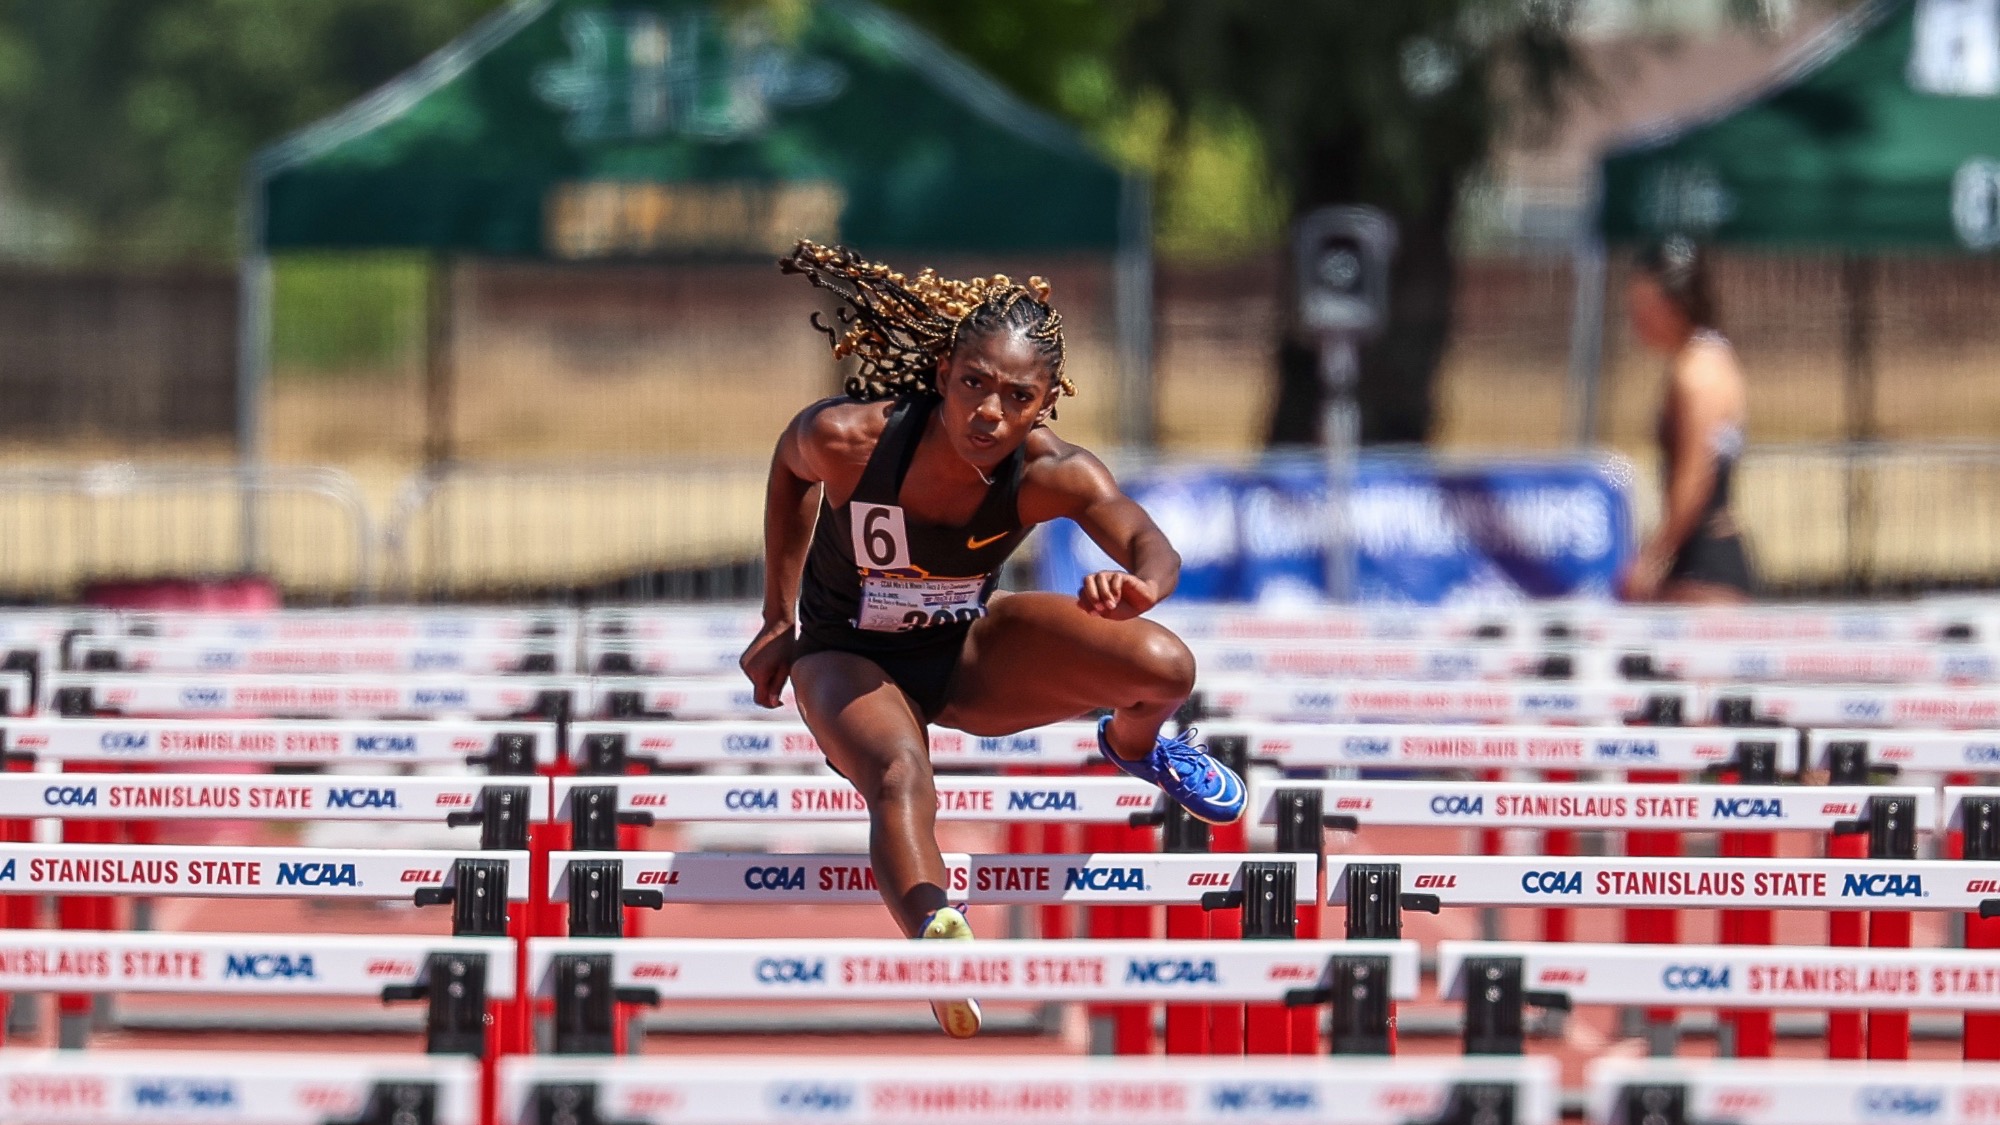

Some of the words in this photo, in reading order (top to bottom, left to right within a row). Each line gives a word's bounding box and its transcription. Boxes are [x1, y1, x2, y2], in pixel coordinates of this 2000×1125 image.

[863, 507, 896, 566] 6
[159, 731, 278, 752] STANISLAUS
[284, 733, 341, 753] STATE
[44, 786, 97, 807] CCAA
[110, 786, 241, 809] STANISLAUS
[249, 787, 313, 809] STATE
[326, 788, 397, 809] NCAA
[630, 794, 668, 808] GILL
[724, 788, 779, 812] CCAA
[1008, 790, 1077, 812] NCAA
[1115, 794, 1153, 808] GILL
[1430, 795, 1483, 816] CCAA
[1495, 795, 1627, 819] STANISLAUS
[1636, 796, 1699, 819] STATE
[1711, 797, 1781, 820] NCAA
[30, 858, 179, 884] STANISLAUS
[188, 860, 261, 885] STATE
[276, 862, 356, 887] NCAA
[400, 868, 443, 884] GILL
[636, 870, 680, 885] GILL
[744, 866, 805, 891] CCAA
[976, 867, 1050, 892] STATE
[1064, 867, 1145, 892] NCAA
[1187, 872, 1230, 887] GILL
[1415, 874, 1457, 889] GILL
[1521, 871, 1582, 895] CCAA
[1596, 871, 1745, 897] STANISLAUS
[1754, 872, 1826, 898] STATE
[1841, 873, 1922, 897] NCAA
[122, 950, 204, 980] STATE
[224, 952, 316, 980] NCAA
[841, 956, 1014, 985] STANISLAUS
[1023, 958, 1106, 986] STATE
[1125, 958, 1217, 986] NCAA
[1747, 965, 1921, 994] STANISLAUS
[1931, 967, 2000, 995] STAT
